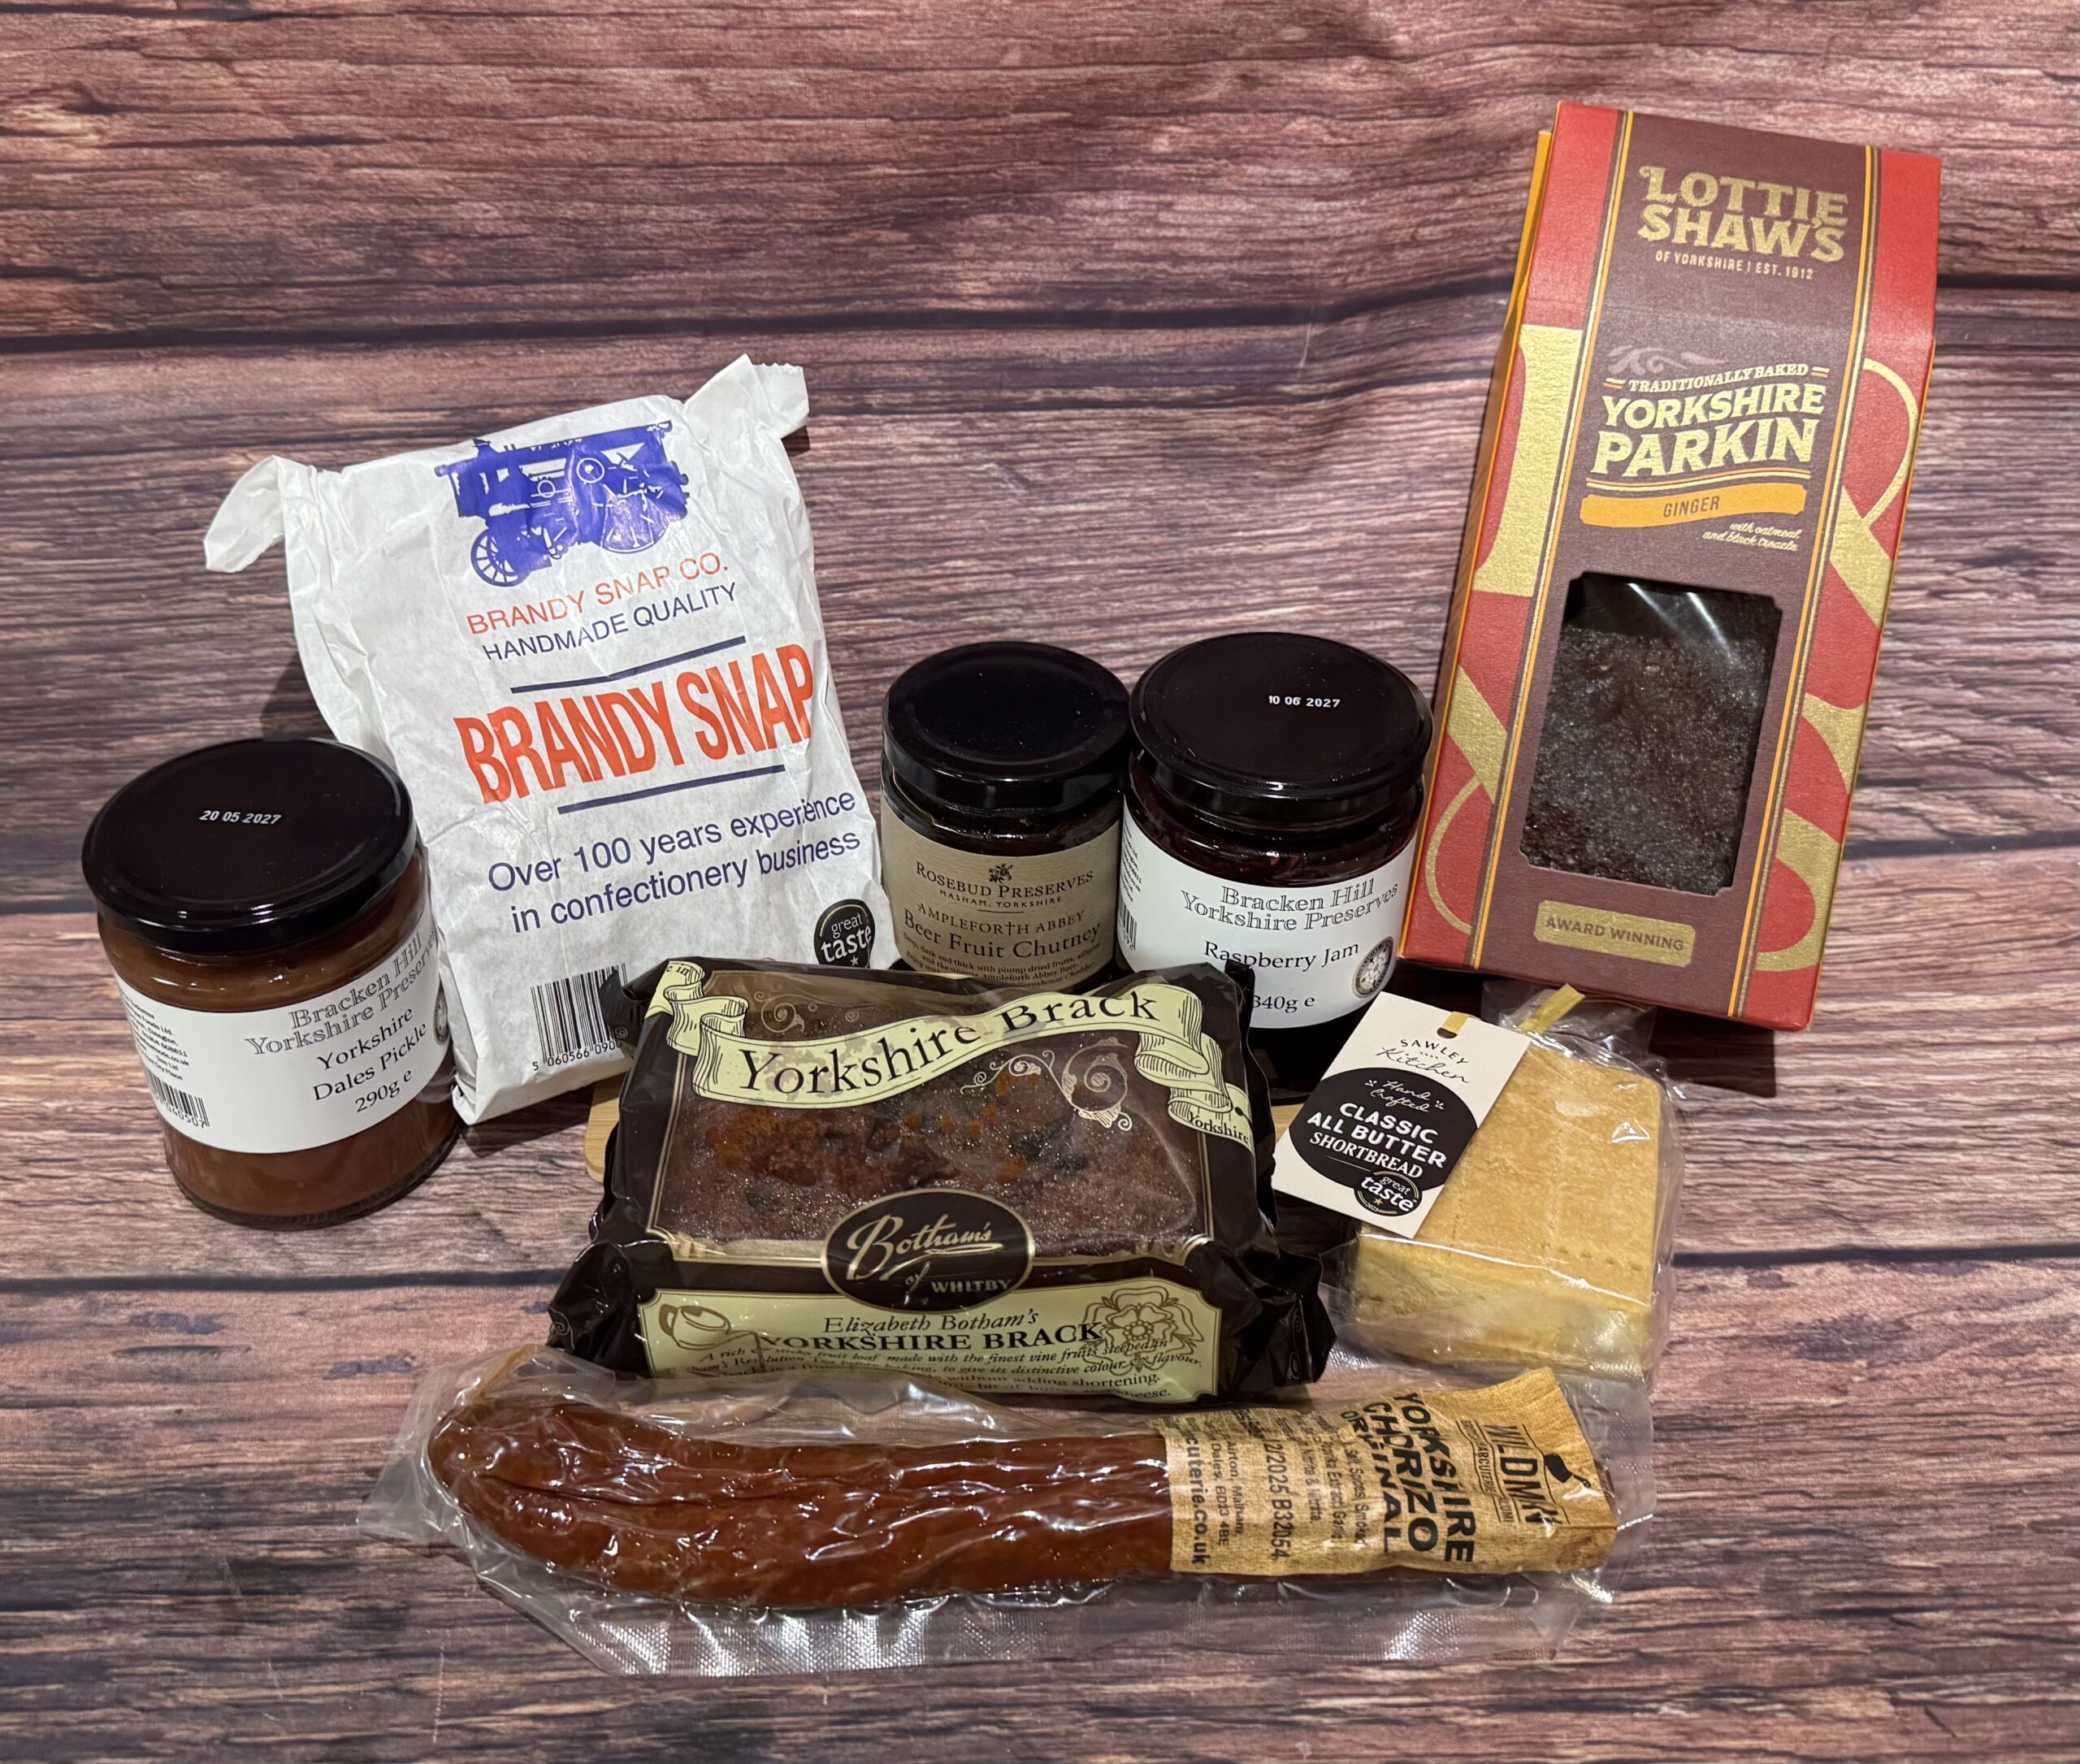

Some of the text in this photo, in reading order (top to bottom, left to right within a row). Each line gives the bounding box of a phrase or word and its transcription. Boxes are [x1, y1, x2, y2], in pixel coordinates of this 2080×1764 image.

[1639, 165, 1849, 228] LOTTIE
[1637, 204, 1846, 264] SHAW'S
[1655, 250, 1814, 280] OF YORKSHIRE EST. 1912
[1629, 363, 1809, 393] TRADITIONALLY BAKED
[1602, 384, 1827, 429] YORKSHIRE
[1590, 418, 1821, 479] PARKIN
[1663, 496, 1720, 518] GINGER
[1702, 531, 1798, 552] and black treacle
[1730, 522, 1754, 533] with
[466, 553, 729, 635] BRANDY SNAP CO.
[482, 583, 737, 661] HANDMADE QUALITY
[1268, 696, 1341, 708] 10 06 2027
[453, 644, 814, 804] BRANDY SNAP
[199, 809, 282, 826] 20 05 2027
[488, 792, 856, 892] Over 100 years experience
[511, 832, 861, 933] in confectionery business
[916, 860, 1094, 898] ROSEBUD PRESERVES
[1221, 878, 1375, 912] Bracken Hill
[996, 896, 1062, 908] YORKSHIRE
[1181, 882, 1398, 931] Yorkshire Preserves
[831, 912, 863, 939] great
[904, 908, 941, 944] Beer
[949, 933, 1004, 958] Fruit
[1012, 924, 1101, 958] Chutney
[1035, 910, 1085, 933] ABBEY
[1545, 917, 1684, 951] AWARD WINNING
[821, 925, 872, 963] taste
[1205, 941, 1316, 972] Raspberry
[1321, 943, 1359, 967] Jam
[288, 973, 391, 1029] Bracken
[392, 931, 422, 977] Hill
[938, 954, 952, 964] and
[954, 960, 974, 969] thick
[977, 964, 995, 973] with
[998, 966, 1026, 974] plump
[1028, 963, 1050, 972] dried
[244, 1006, 374, 1055] Yorkshire
[377, 930, 436, 1012] Preser
[317, 1008, 413, 1071] Yorkshire
[738, 991, 1160, 1096] Yorkshire Brack
[1401, 1038, 1468, 1065] SAWLEY
[313, 1022, 427, 1101] Dales Pickle
[532, 1062, 540, 1071] 5
[548, 1049, 590, 1066] 060566
[1376, 1046, 1470, 1084] Kitchen
[354, 1081, 401, 1112] 290g
[1370, 1089, 1430, 1112] Crafted
[1383, 1080, 1431, 1102] Hand
[1189, 1111, 1249, 1144] Yorkshire
[1306, 1111, 1448, 1168] ALL BUTTER
[1339, 1102, 1440, 1144] CLASSIC
[1309, 1132, 1424, 1179] SHORTBREAD
[1361, 1177, 1414, 1211] taste
[1380, 1177, 1410, 1195] great
[847, 1214, 1003, 1281] Botham's
[905, 1261, 930, 1292] of
[931, 1280, 1013, 1293] WHITBY
[760, 1321, 1103, 1350] YORKSHIRE BRACK
[823, 1308, 1039, 1337] Elizabeth Botham's
[699, 1352, 713, 1363] A
[721, 1348, 745, 1358] rich
[817, 1350, 847, 1359] fruit
[852, 1353, 879, 1362] loaf
[886, 1354, 923, 1363] made
[929, 1353, 959, 1363] with
[964, 1354, 984, 1363] the
[984, 1353, 1025, 1364] finest
[1029, 1353, 1056, 1362] vine
[1057, 1347, 1098, 1363] fruits
[1103, 1341, 1152, 1355] steeped
[942, 1365, 956, 1373] to
[958, 1366, 986, 1375] give
[989, 1366, 1008, 1374] its
[1011, 1364, 1080, 1375] distinctive
[1084, 1360, 1125, 1373] colour
[1150, 1350, 1202, 1367] flavour.
[1363, 1402, 1438, 1551] CHORIZO
[1393, 1393, 1476, 1562] YORKSHIRE
[1484, 1425, 1562, 1524] WILDMN
[1216, 1485, 1229, 1516] BD23
[1218, 1521, 1230, 1546] 4BE
[1271, 1499, 1294, 1560] B32054
[1354, 1504, 1370, 1544] Smoked
